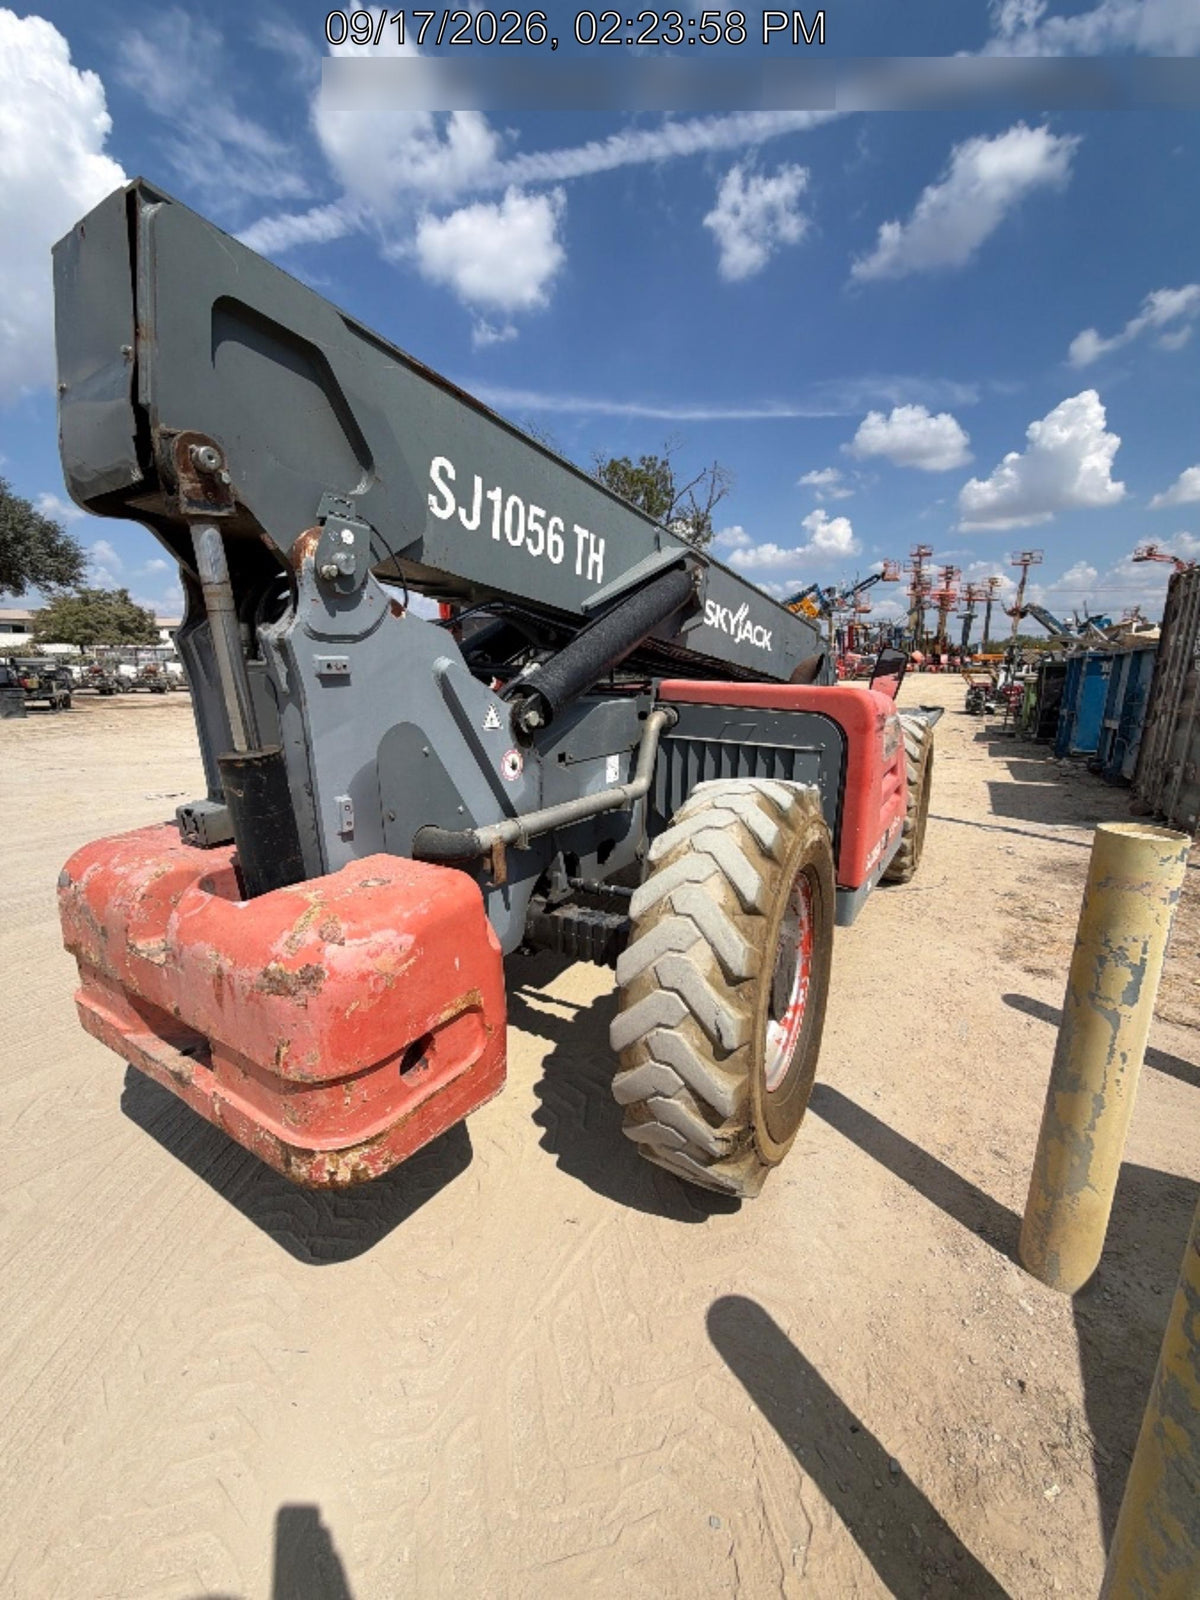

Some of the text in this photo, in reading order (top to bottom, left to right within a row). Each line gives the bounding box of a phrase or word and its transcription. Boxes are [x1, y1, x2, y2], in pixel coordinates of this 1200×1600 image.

[428, 456, 606, 584] SJ1056 TH
[703, 599, 773, 652] SKYJACK
